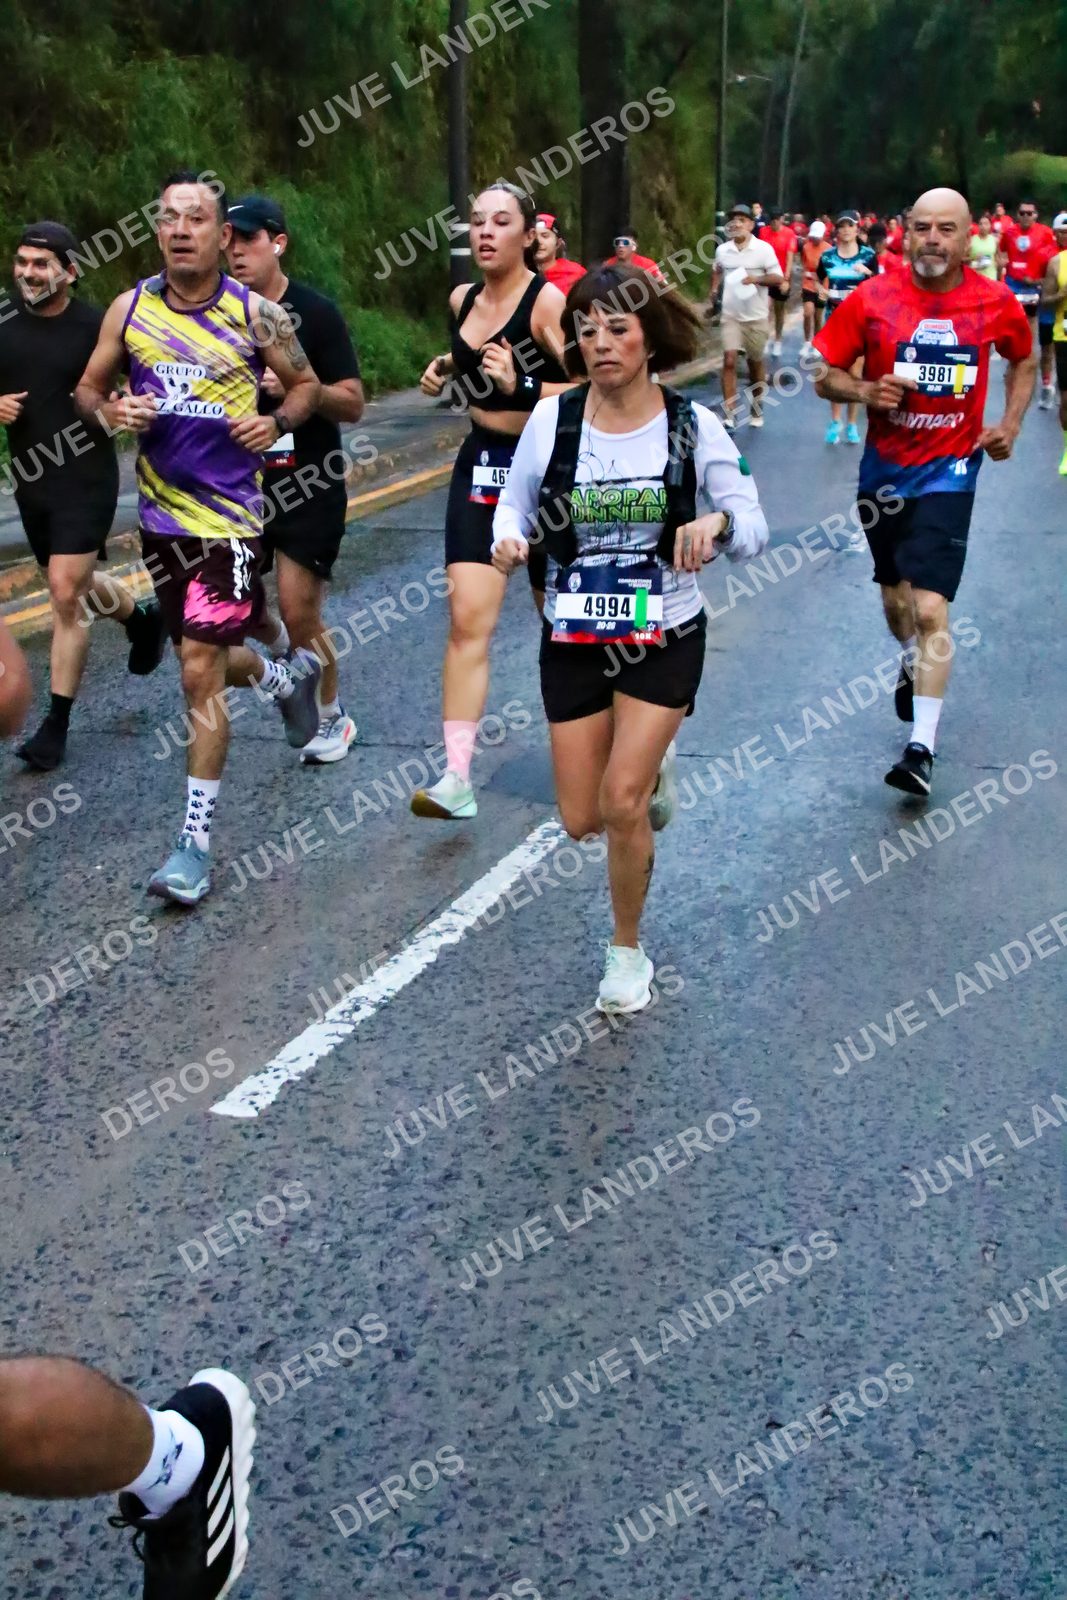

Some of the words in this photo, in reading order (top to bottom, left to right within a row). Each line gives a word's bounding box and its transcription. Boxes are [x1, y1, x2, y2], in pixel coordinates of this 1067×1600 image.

[156, 364, 203, 378] GRUPO
[918, 365, 952, 383] 3981
[173, 403, 223, 415] GALLO
[570, 488, 668, 505] APOPA
[570, 505, 668, 523] UNNER
[583, 596, 631, 618] 4994
[634, 632, 652, 640] 10K
